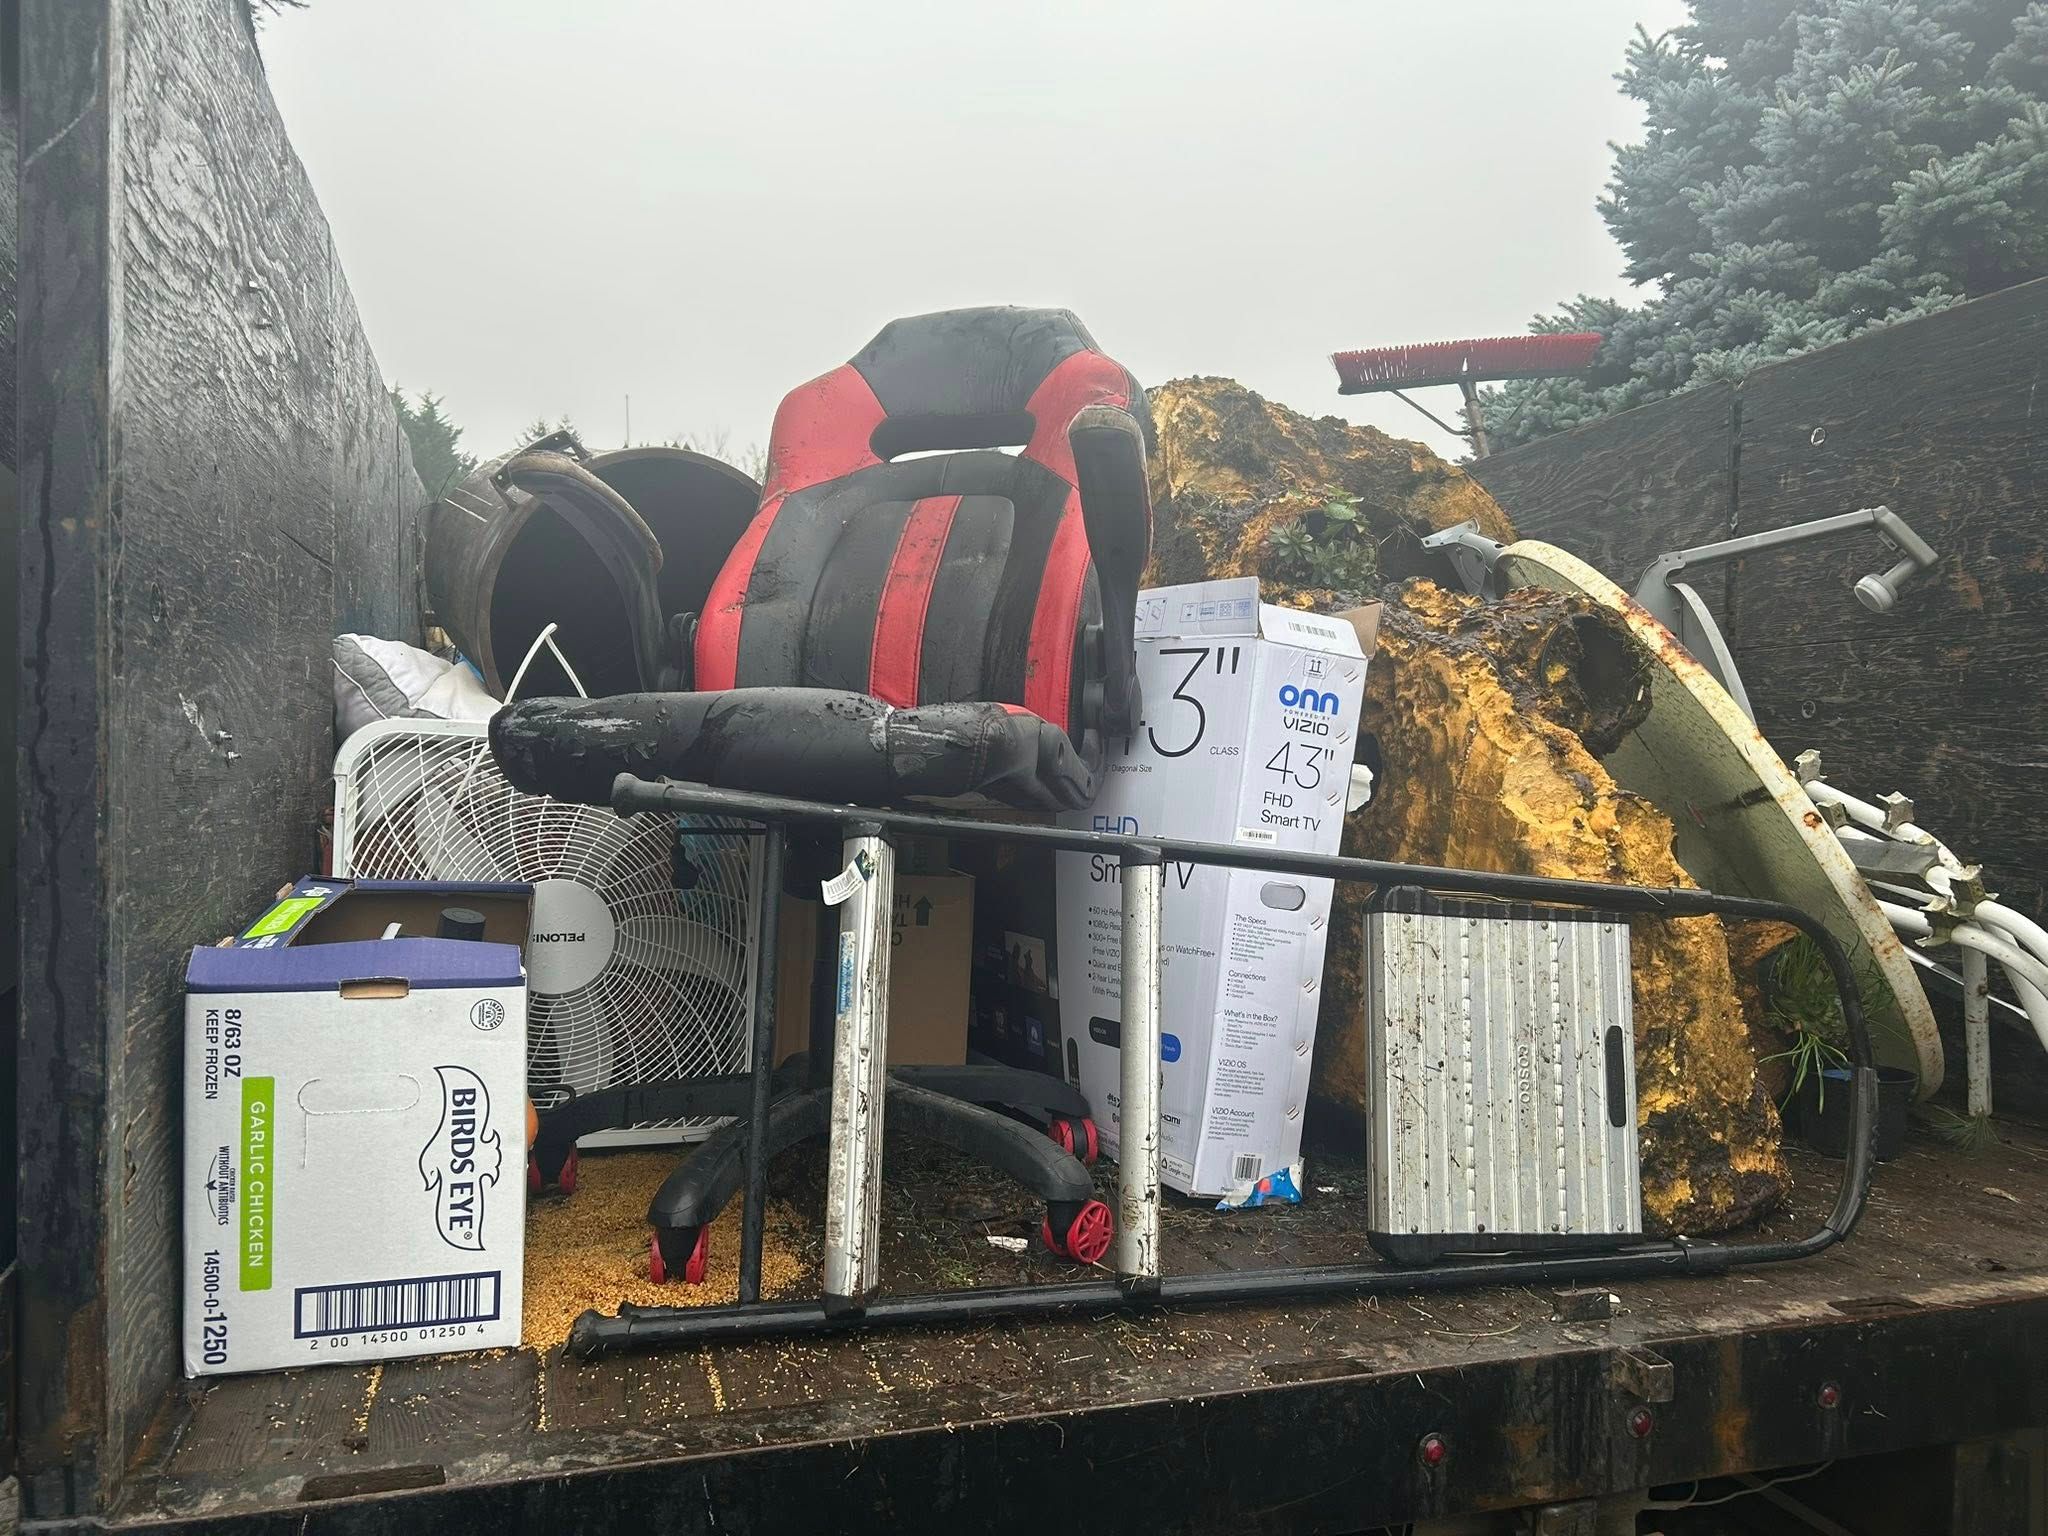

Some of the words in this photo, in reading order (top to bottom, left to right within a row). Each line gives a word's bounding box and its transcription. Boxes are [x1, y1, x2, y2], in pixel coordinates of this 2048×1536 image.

[1125, 646, 1240, 757] 3"
[1279, 684, 1339, 715] onn
[1283, 716, 1329, 736] VIZIO
[1284, 708, 1318, 719] POWERED
[1209, 746, 1239, 756] CLASS
[1111, 763, 1138, 775] Diagonal
[1139, 764, 1152, 772] Size
[1265, 740, 1334, 789] 43"
[1263, 791, 1293, 808] FHD
[1093, 815, 1139, 836] FHD
[1260, 810, 1299, 829] Smart
[1302, 816, 1321, 831] TV
[1248, 915, 1267, 925] Specs
[1176, 944, 1216, 957] WatchFree+
[1228, 969, 1267, 981] Connections
[205, 1009, 218, 1044] KEEP
[1224, 1009, 1245, 1019] What's
[224, 1008, 241, 1049] 8/63
[205, 1048, 218, 1100] FROZEN
[224, 1055, 241, 1078] OZ
[1218, 1058, 1236, 1067] VIZIO
[1237, 1060, 1247, 1069] OS
[1517, 1045, 1531, 1104] COSCO
[1212, 1106, 1229, 1116] VIZIO
[1229, 1109, 1255, 1118] Account
[249, 1101, 265, 1174] GARLIC
[450, 1087, 476, 1174] BIRDS
[218, 1146, 229, 1180] WITHOUT
[217, 1181, 228, 1226] ANTIBIOTICS
[449, 1181, 473, 1230] EYE
[248, 1181, 264, 1267] CHICKEN
[203, 1249, 227, 1365] 14500-0-1250
[310, 1340, 318, 1350] 2
[330, 1336, 349, 1348] 00
[360, 1330, 409, 1345] 14500
[419, 1325, 466, 1341] 01250
[476, 1324, 485, 1334] 4
